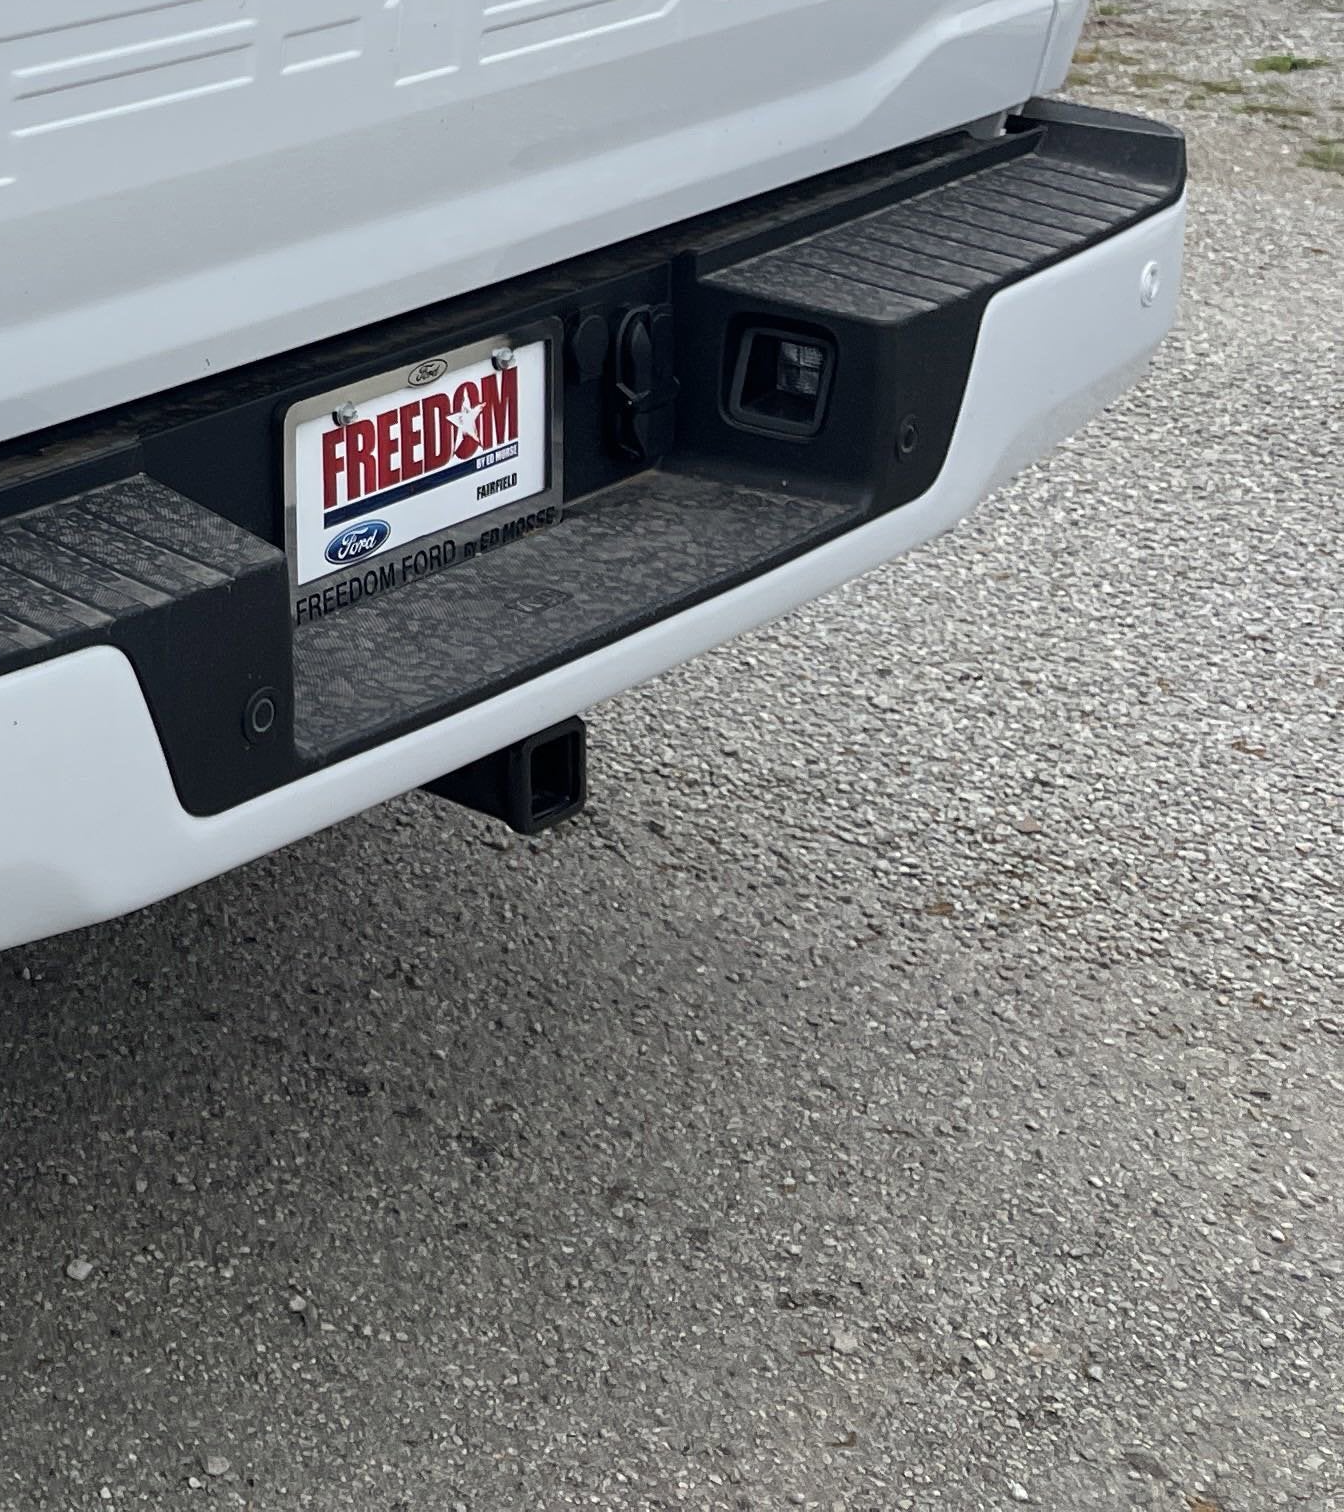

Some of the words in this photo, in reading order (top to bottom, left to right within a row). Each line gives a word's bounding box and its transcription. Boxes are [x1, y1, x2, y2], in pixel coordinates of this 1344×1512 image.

[322, 366, 519, 510] FREEDOM
[476, 472, 518, 501] FAIRFIELD
[337, 526, 378, 560] Ford
[296, 562, 396, 626] FREEDOM
[401, 539, 457, 583] FORD
[480, 527, 500, 551] ED
